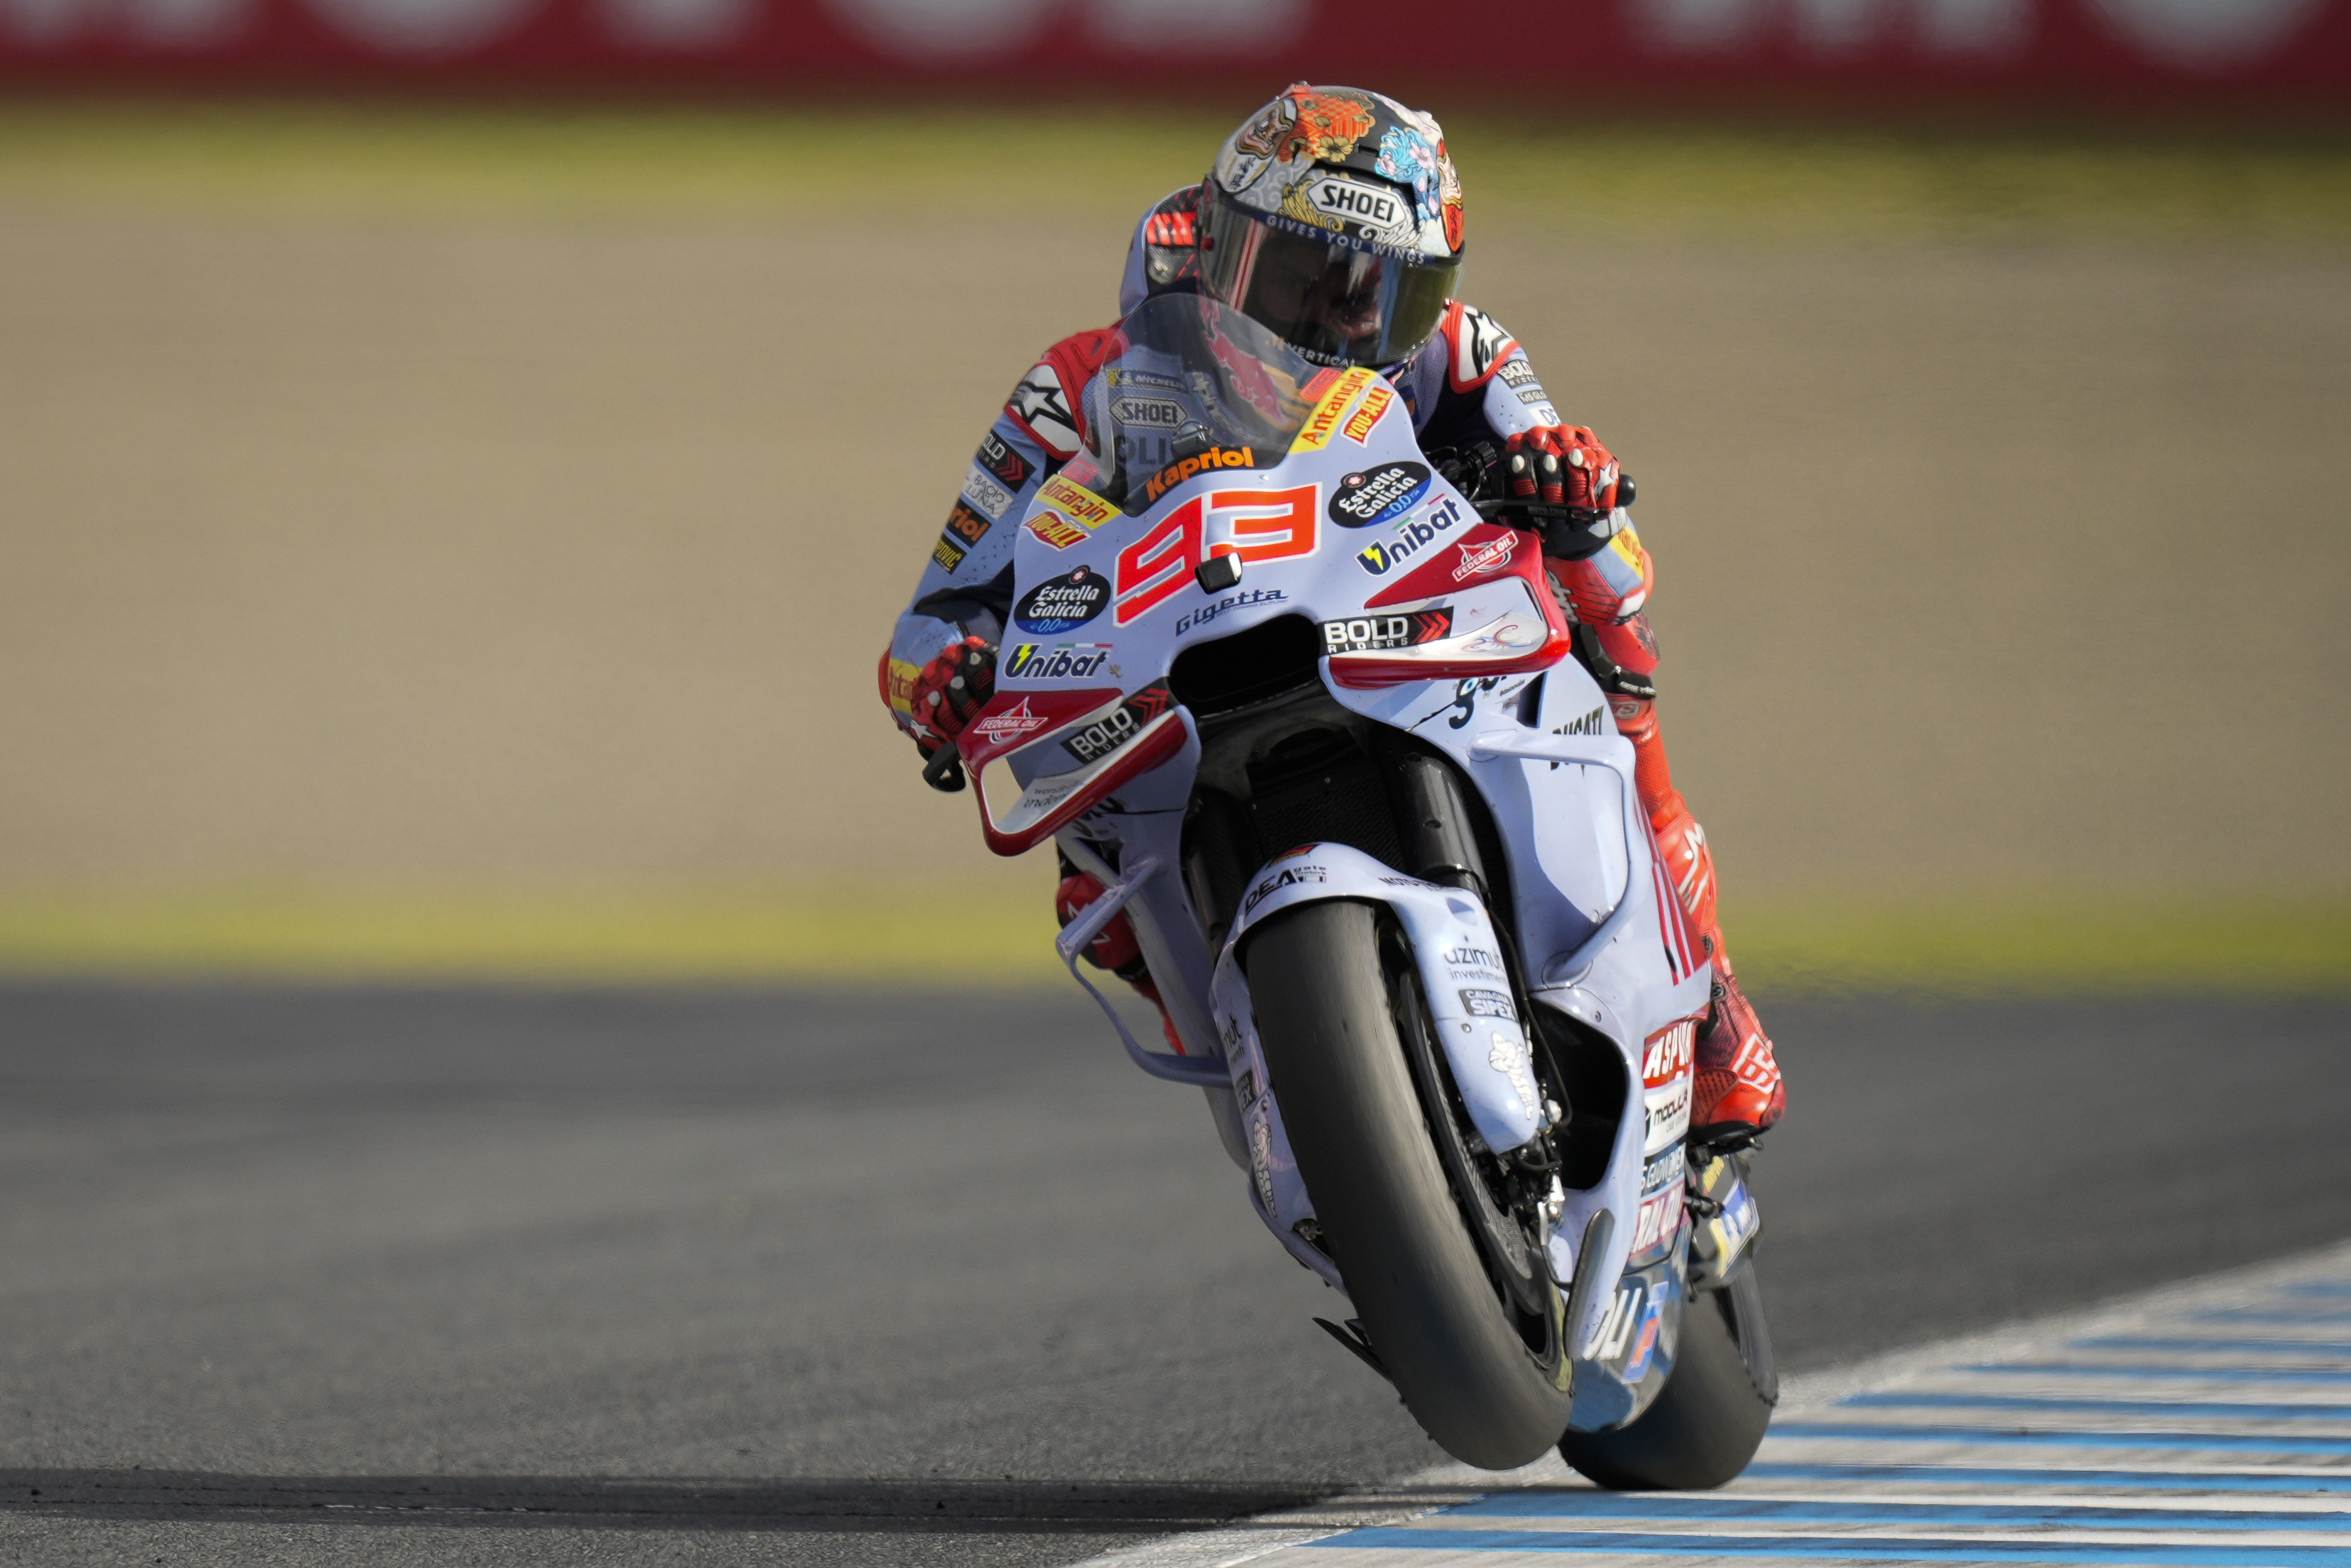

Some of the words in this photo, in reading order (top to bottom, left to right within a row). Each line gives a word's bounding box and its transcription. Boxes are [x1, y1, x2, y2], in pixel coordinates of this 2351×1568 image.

[1321, 184, 1395, 222] SHOEI
[1267, 215, 1316, 238] GIVES
[1326, 231, 1362, 250] YOU
[1371, 243, 1425, 265] WINGS
[1291, 344, 1357, 368] VERTICAL
[1497, 360, 1534, 380] BOLD
[1121, 402, 1178, 424] SHOEI
[1301, 371, 1370, 445] Antangin
[1345, 386, 1394, 441] YOU-ALL
[983, 433, 1006, 460] OLD
[1146, 446, 1255, 501] Kapriol
[1338, 468, 1405, 513] Estrella
[1042, 478, 1108, 523] Antangin
[1355, 477, 1418, 518] Galicia
[951, 507, 989, 541] riol
[1358, 498, 1463, 575] Unibat
[1114, 482, 1321, 627] 93
[1456, 547, 1497, 577] FEDERAL
[1496, 538, 1513, 552] OIL
[1029, 601, 1088, 618] Galicia
[1034, 585, 1099, 601] Estrella
[1175, 590, 1289, 636] Gigetta
[1324, 617, 1408, 644] BOLD
[1005, 644, 1110, 678] Unibat
[1328, 638, 1408, 653] RIDERS
[981, 719, 1022, 729] FEDERAL
[1020, 719, 1038, 728] OIL
[1070, 708, 1133, 755] BOLD
[1245, 869, 1296, 915] DEA
[1470, 998, 1516, 1021] SIPEX
